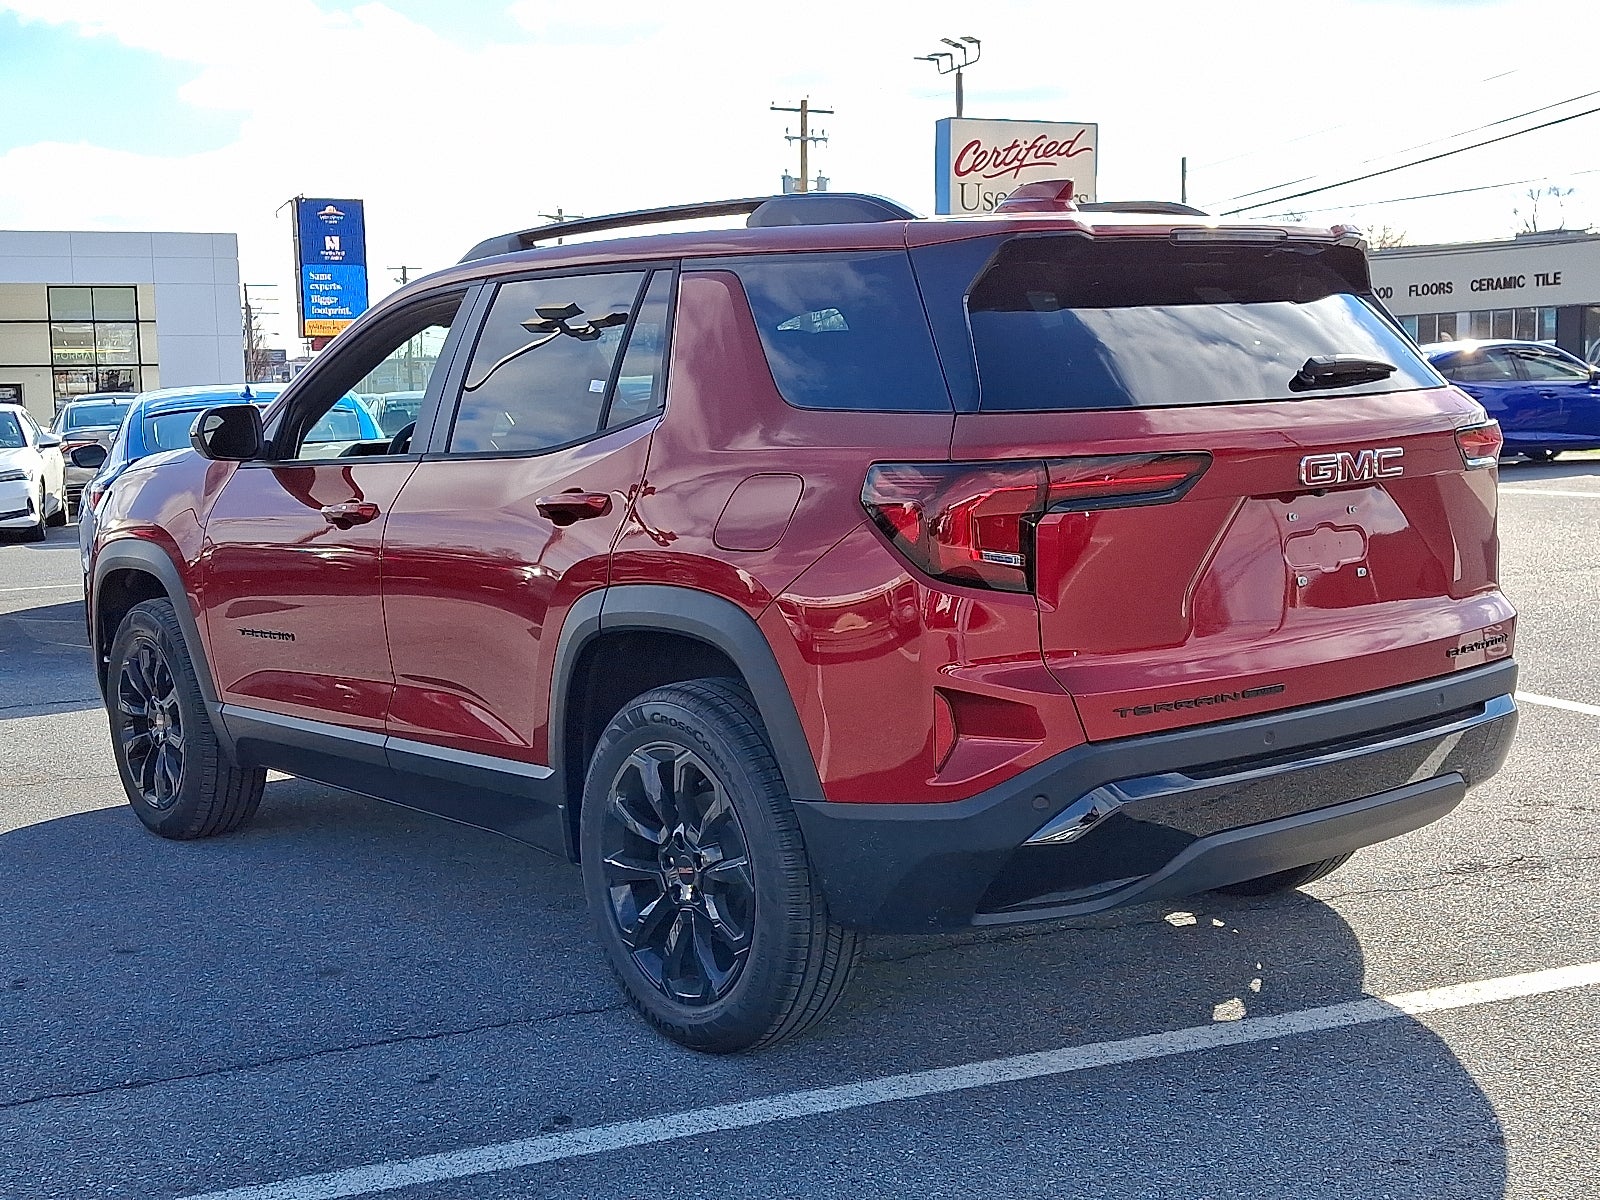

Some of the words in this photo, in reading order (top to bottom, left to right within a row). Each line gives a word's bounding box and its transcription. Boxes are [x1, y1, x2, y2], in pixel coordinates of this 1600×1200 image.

[954, 129, 1093, 179] Certified
[958, 183, 1008, 211] Use
[1408, 282, 1453, 297] FLOORS
[1470, 274, 1526, 292] CERAMIC
[1534, 272, 1562, 287] TILE
[1299, 447, 1404, 486] GMC
[1113, 692, 1241, 718] TERRAIN
